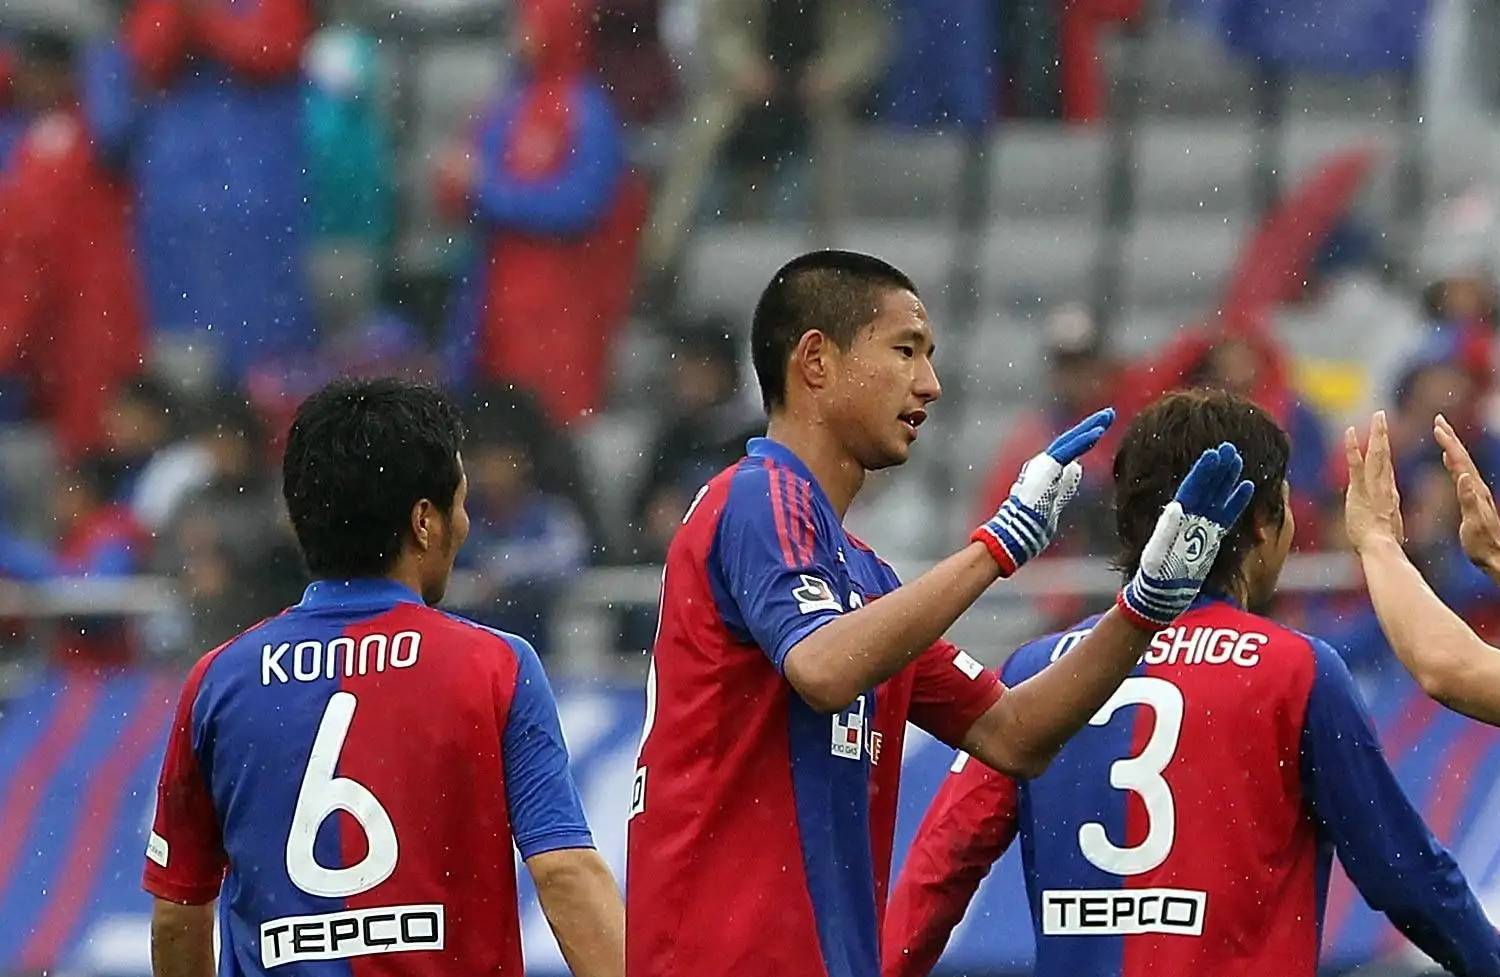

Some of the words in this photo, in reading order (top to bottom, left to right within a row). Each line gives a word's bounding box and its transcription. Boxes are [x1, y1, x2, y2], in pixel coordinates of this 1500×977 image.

[262, 631, 421, 685] KONNO
[1051, 626, 1268, 667] SHIGE
[286, 691, 398, 898] 6
[1078, 676, 1185, 876] 3
[264, 910, 439, 958] TEPCO
[1050, 896, 1197, 928] TEPCO
